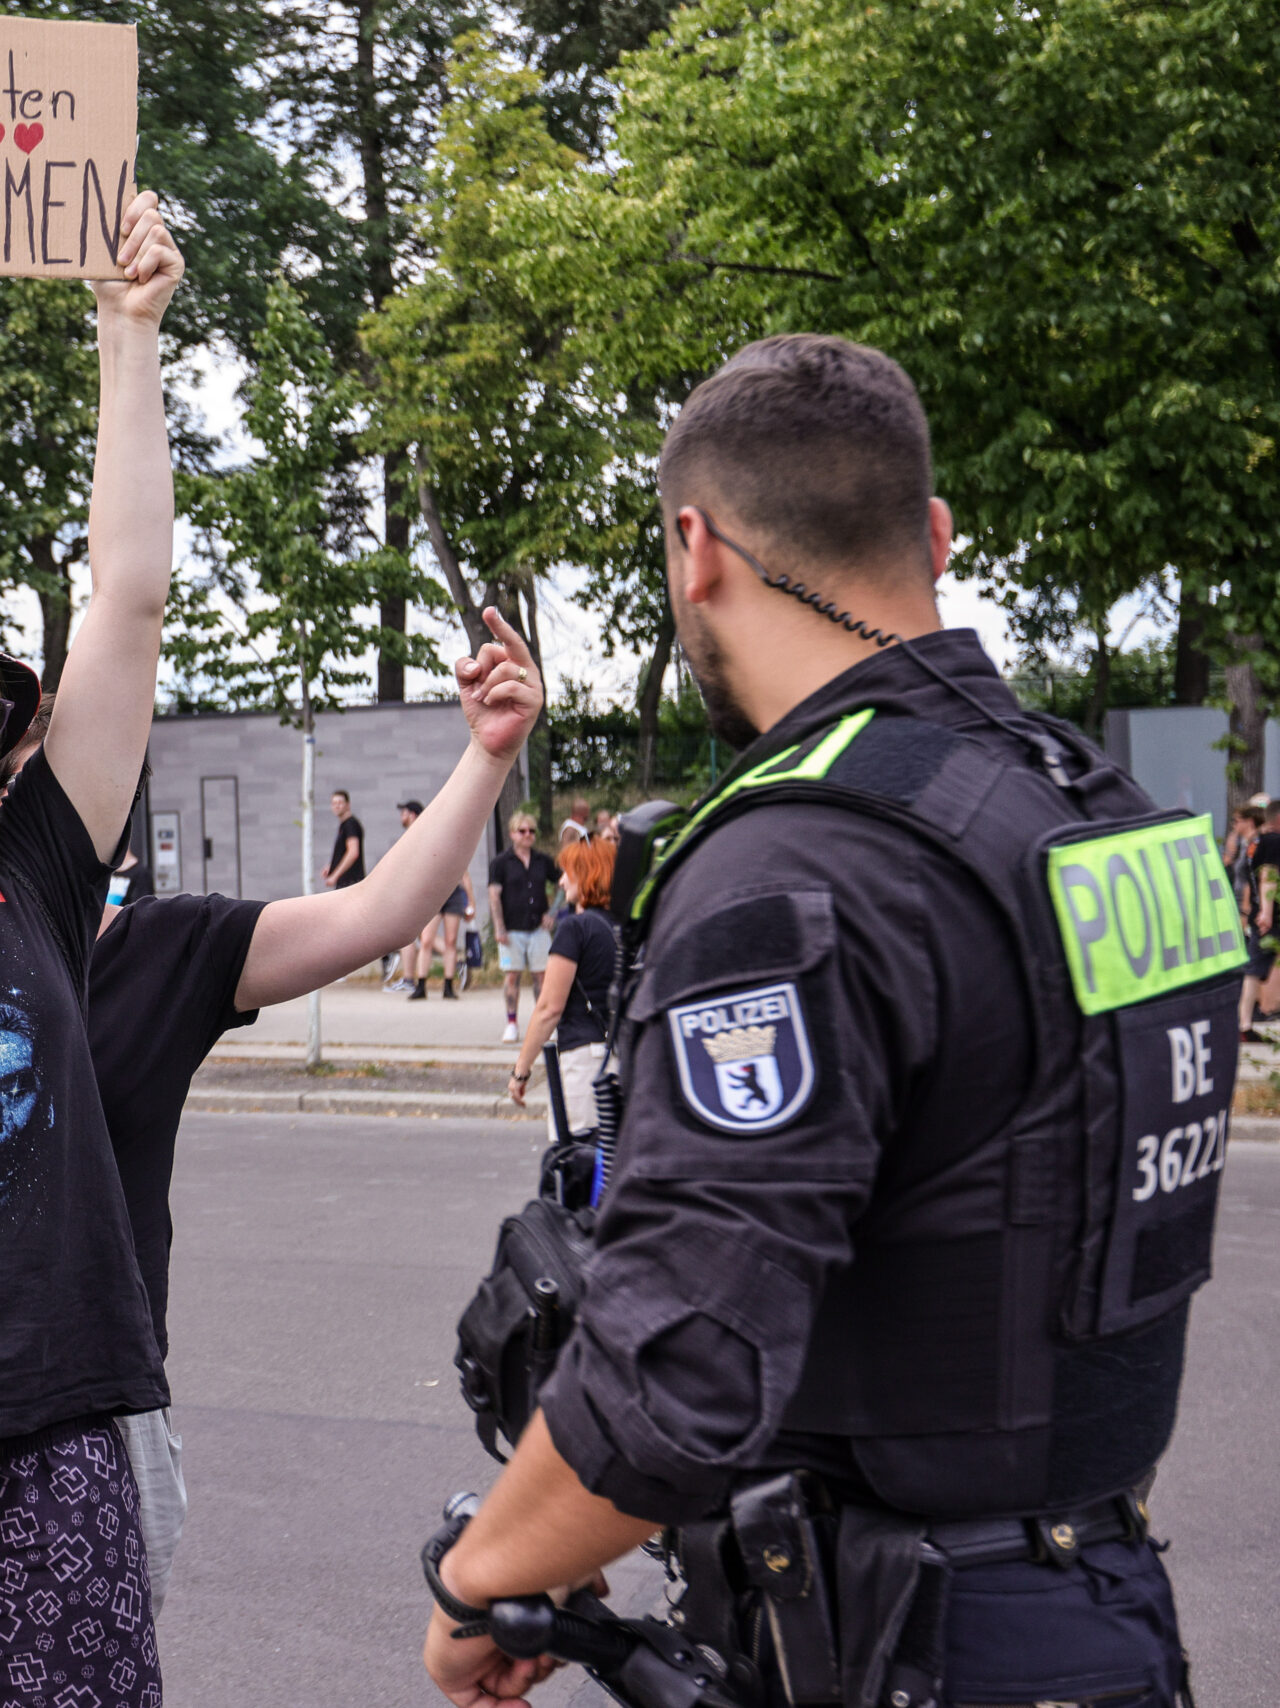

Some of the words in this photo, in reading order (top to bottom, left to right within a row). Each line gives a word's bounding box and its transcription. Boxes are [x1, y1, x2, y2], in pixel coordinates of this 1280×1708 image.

[1059, 833, 1237, 994] POLIZE
[681, 994, 791, 1038] POLIZEI
[1166, 1019, 1214, 1104] BE
[1132, 1109, 1227, 1202] 36221
